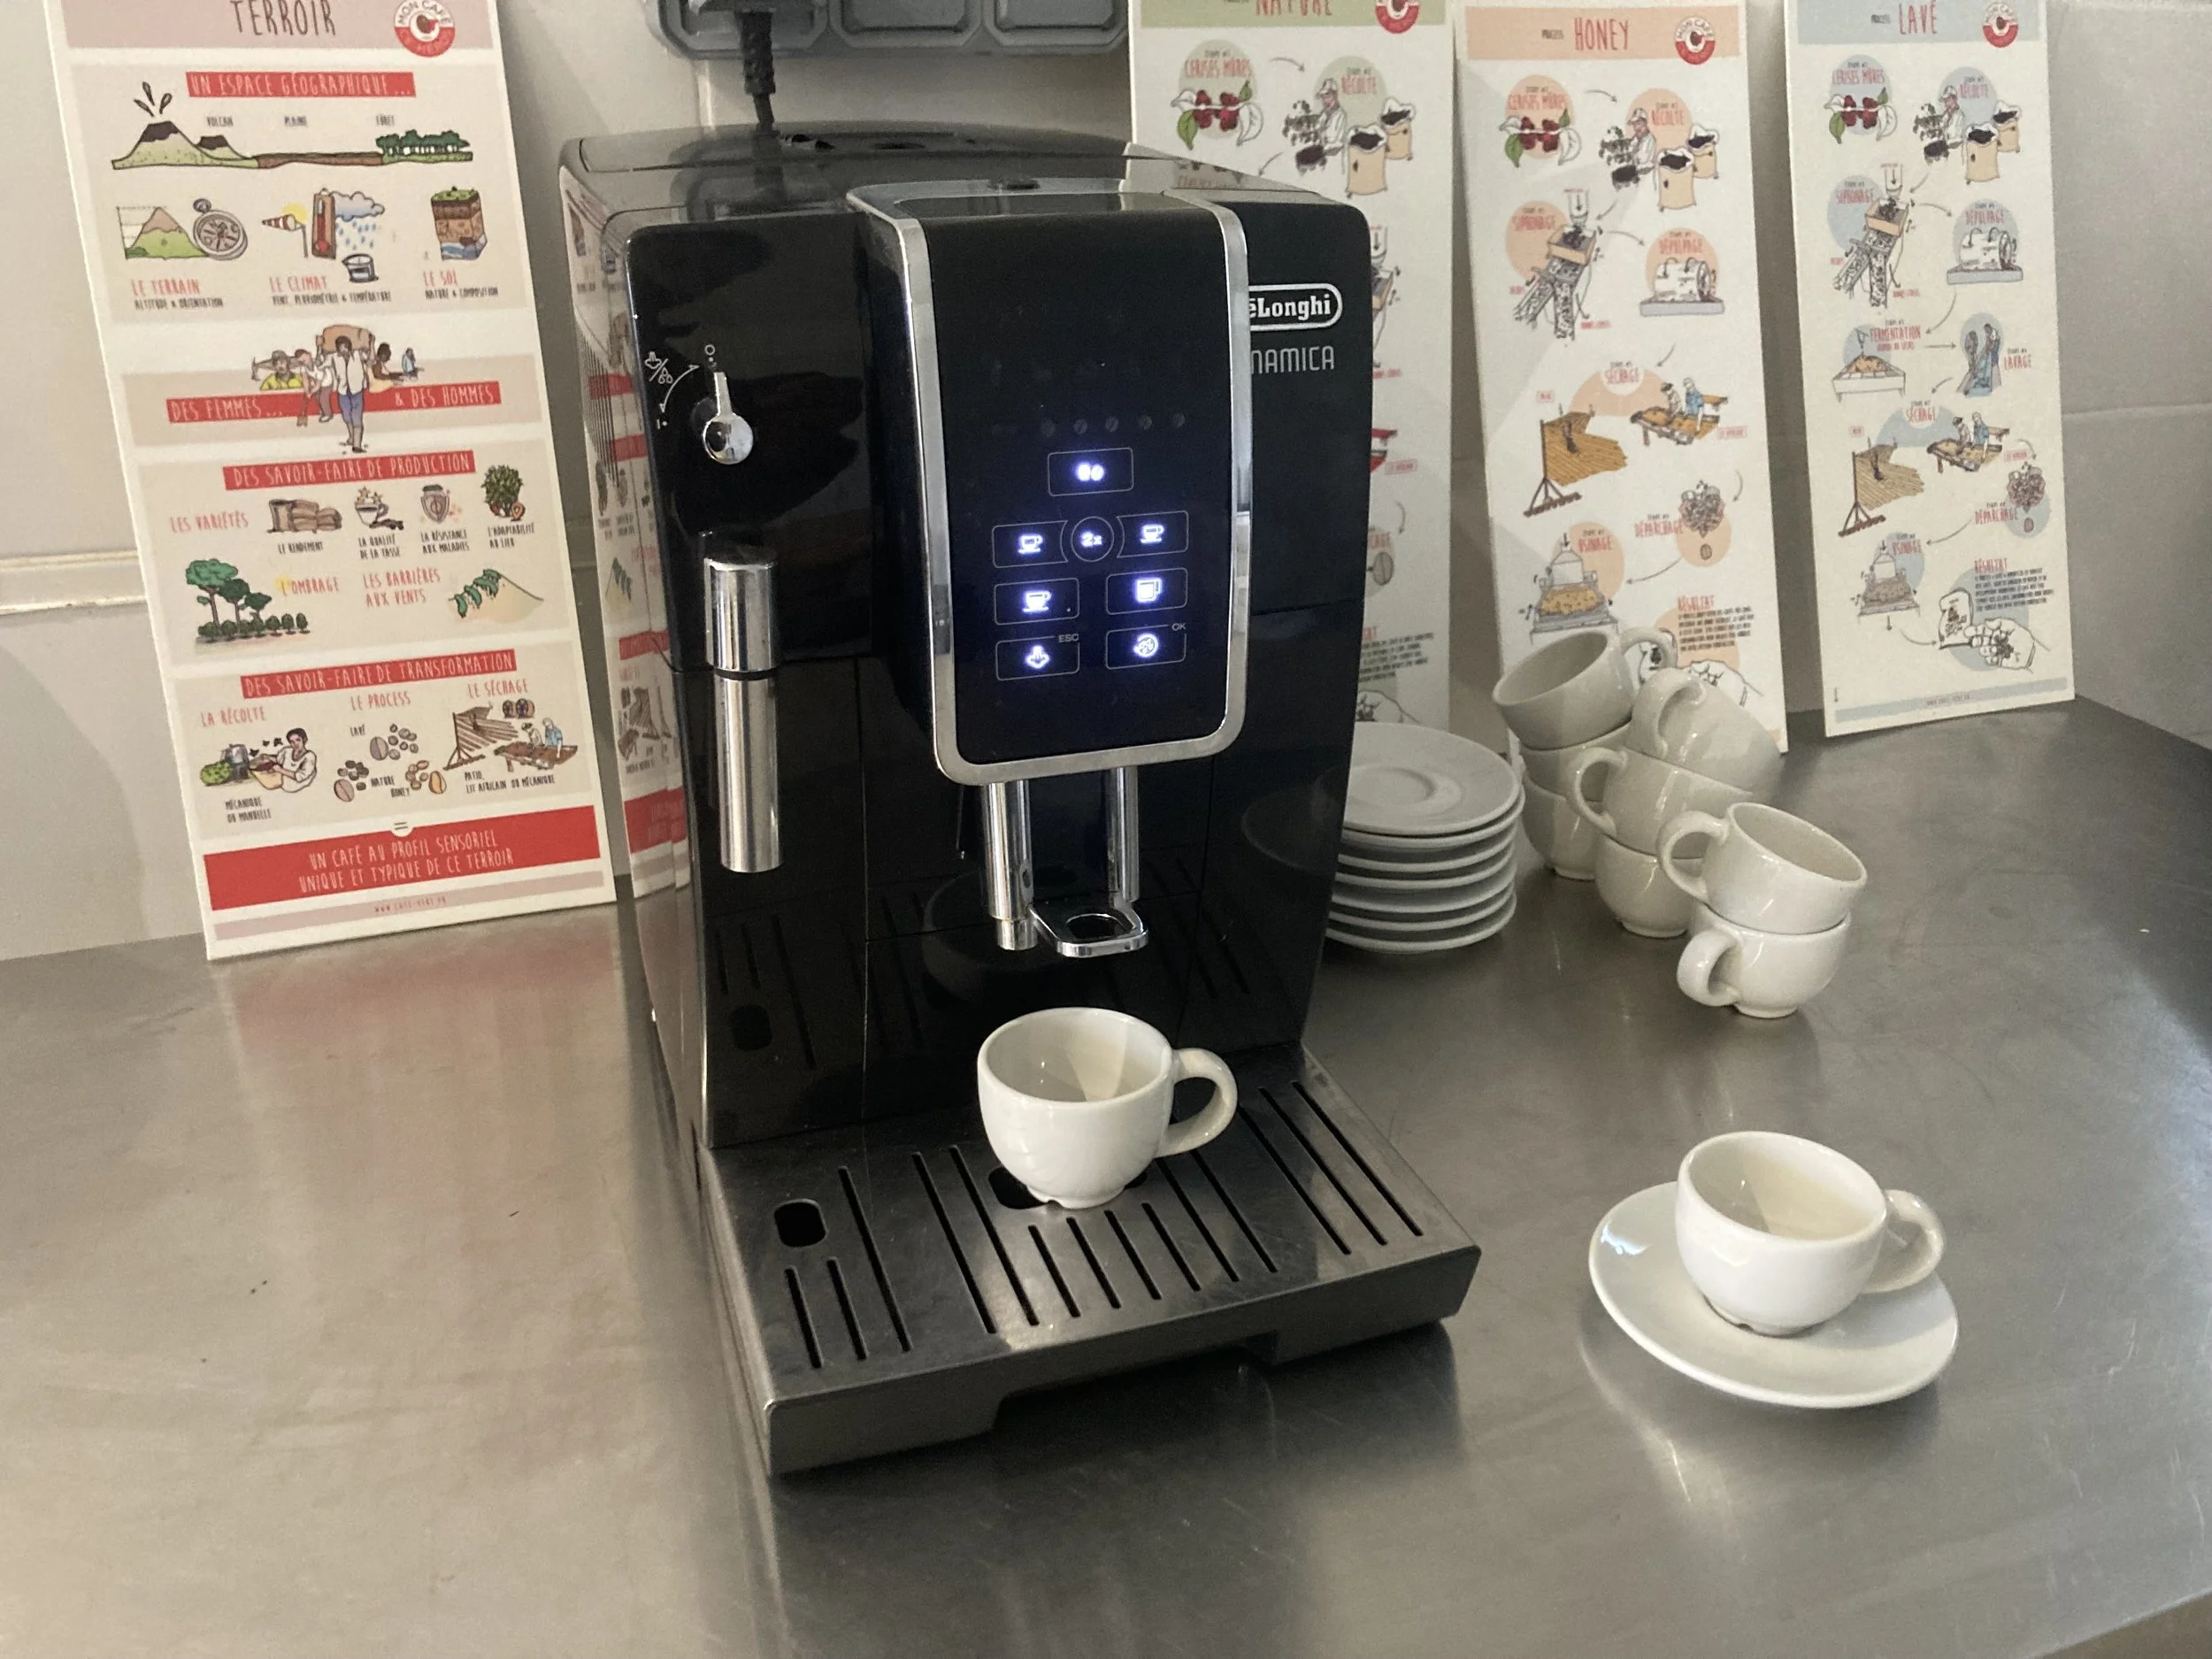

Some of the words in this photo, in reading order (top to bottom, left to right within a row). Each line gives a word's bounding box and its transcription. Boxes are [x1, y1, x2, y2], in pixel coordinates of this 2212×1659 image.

[230, 0, 335, 35] TERROIR
[1899, 0, 1938, 35] LAVÉ
[1574, 17, 1629, 51] HONEY
[191, 75, 211, 95] UN
[220, 73, 273, 96] ESPACE
[280, 72, 388, 96] GÉOGRAPHIQUE
[206, 115, 234, 127] VOLCAN
[132, 280, 145, 296] LE
[151, 279, 200, 296] TERRAIN
[269, 276, 282, 293] LE
[288, 275, 327, 291] CLIMAT
[424, 272, 434, 287] LE
[441, 270, 457, 286] SOL
[1870, 325, 1922, 343] FERMENTATION
[1250, 345, 1335, 374] NAMICA
[2004, 355, 2032, 371] LAVAGE
[172, 401, 199, 422] DES
[205, 398, 263, 419] FEMMES
[411, 388, 435, 407] DES
[442, 384, 495, 405] HOMMES
[234, 467, 259, 488] DES
[266, 461, 365, 486] SAVOIR-FAIRE
[367, 461, 383, 479] DE
[390, 453, 470, 477] PRODUCTION
[170, 517, 191, 534] LES
[196, 511, 250, 530] VARIÉTÉS
[358, 537, 367, 548] LA
[420, 531, 430, 541] LA
[489, 539, 499, 549] AU
[502, 537, 515, 548] LIEU
[1080, 532, 1102, 548] 2x
[278, 543, 287, 555] LE
[288, 541, 324, 553] RENDEMENT
[360, 550, 368, 559] DE
[370, 549, 380, 558] LA
[382, 547, 401, 557] TASSE
[423, 544, 436, 555] AUX
[439, 541, 470, 554] MALADIES
[281, 577, 340, 596] L'OMBRAGE
[363, 573, 381, 589] LES
[386, 567, 441, 587] BARRIÈRES
[366, 592, 389, 608] AUX
[395, 588, 426, 605] VENTS
[1059, 634, 1079, 643] ESC
[246, 675, 271, 696] DES
[277, 665, 374, 694] SAVOIR-FAIRE
[376, 664, 393, 683] DE
[399, 653, 512, 681] TRANSFORMATION
[468, 683, 480, 699] LE
[486, 678, 530, 697] SÉCHAGE
[350, 695, 363, 711] LE
[368, 691, 411, 707] PROCESS
[201, 712, 215, 727] LA
[220, 705, 267, 726] RÉCOLTE
[350, 724, 365, 737] LAVÉ
[371, 775, 396, 787] NATURE
[465, 783, 477, 794] LIT
[478, 780, 507, 793] AFRICAIN
[521, 773, 556, 788] MÉCANIQUE
[225, 797, 263, 810] MÉCANIQUE
[239, 809, 272, 823] MANUELLE
[310, 853, 326, 871] UN
[332, 844, 362, 867] CAFÉ
[368, 844, 386, 862] AU
[392, 839, 431, 859] PROFIL
[436, 829, 498, 854] SENSORIEL
[298, 872, 344, 894] UNIQUE
[350, 868, 365, 885] ET
[371, 862, 421, 882] TYPIQUE
[426, 857, 441, 875] DE
[446, 856, 461, 873] CE
[466, 848, 514, 870] TERROIR
